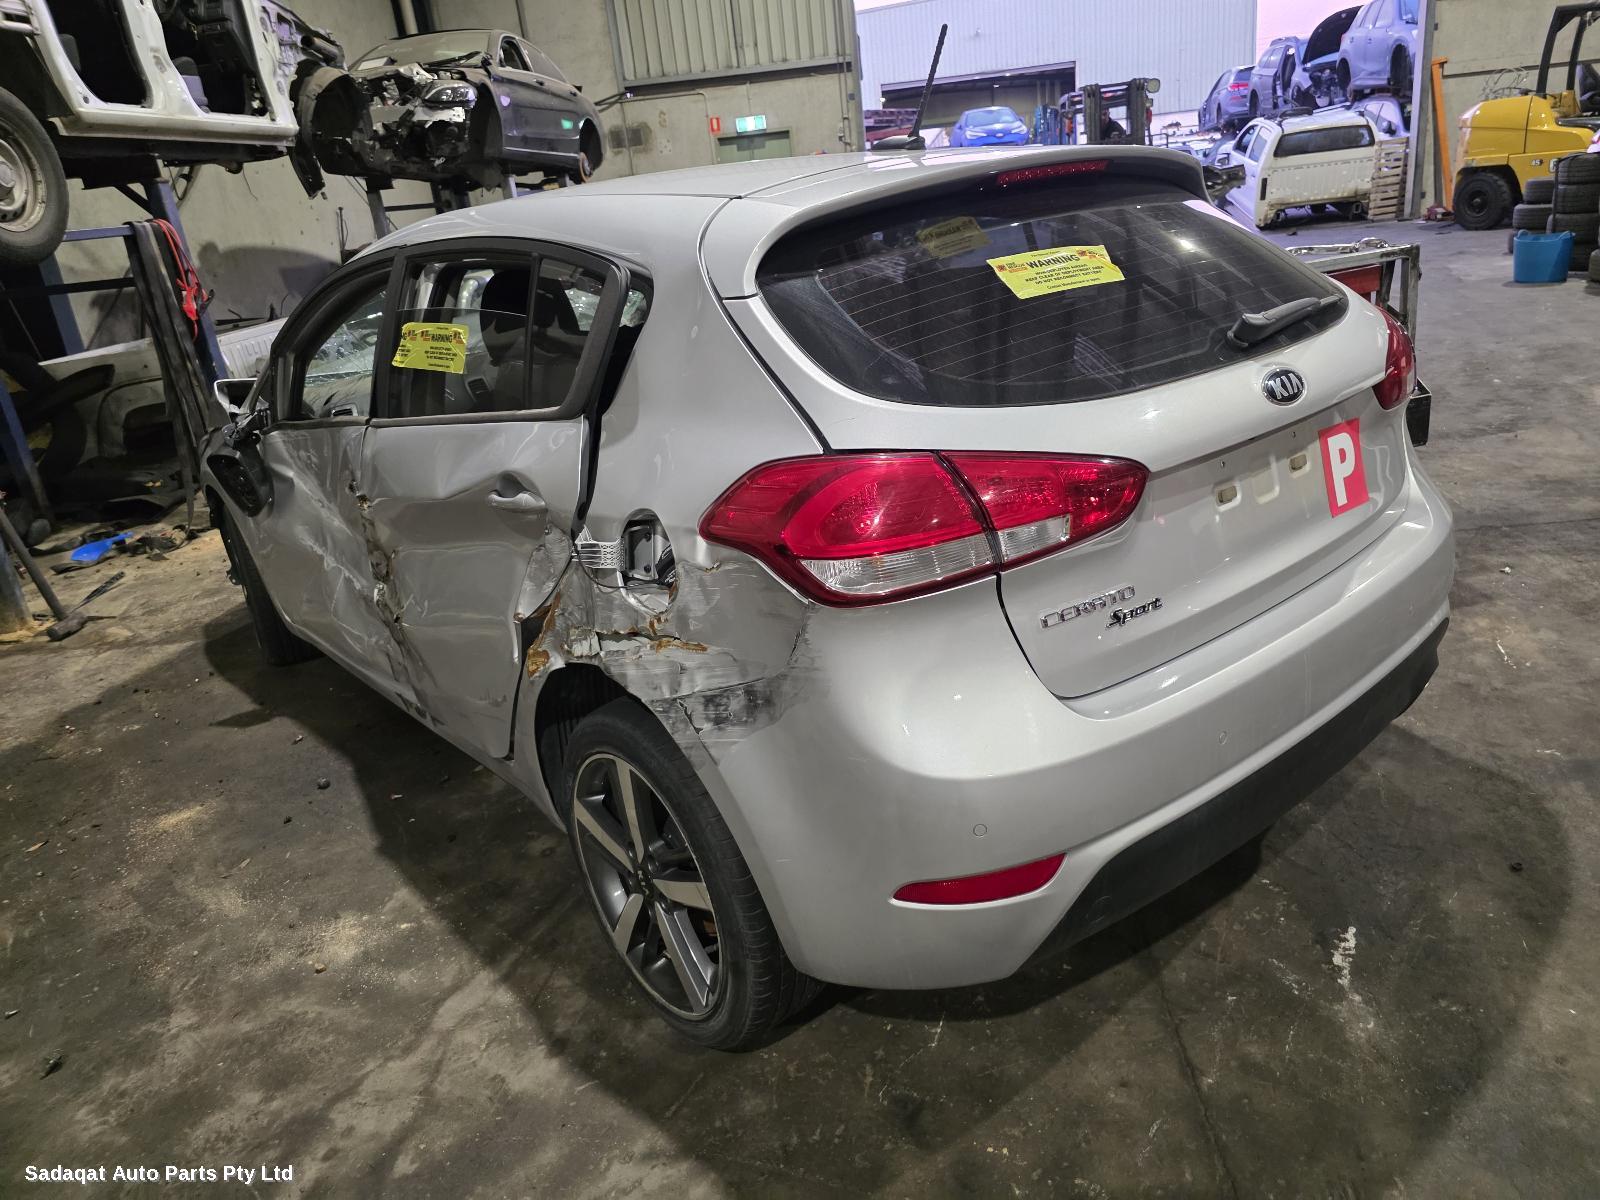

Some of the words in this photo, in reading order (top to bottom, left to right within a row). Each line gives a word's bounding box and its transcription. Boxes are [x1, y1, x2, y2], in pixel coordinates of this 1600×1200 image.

[1026, 254, 1081, 269] WARNING
[431, 332, 453, 344] WARNING
[1267, 372, 1303, 400] KIA
[1327, 432, 1356, 508] P
[1105, 596, 1163, 629] Sport
